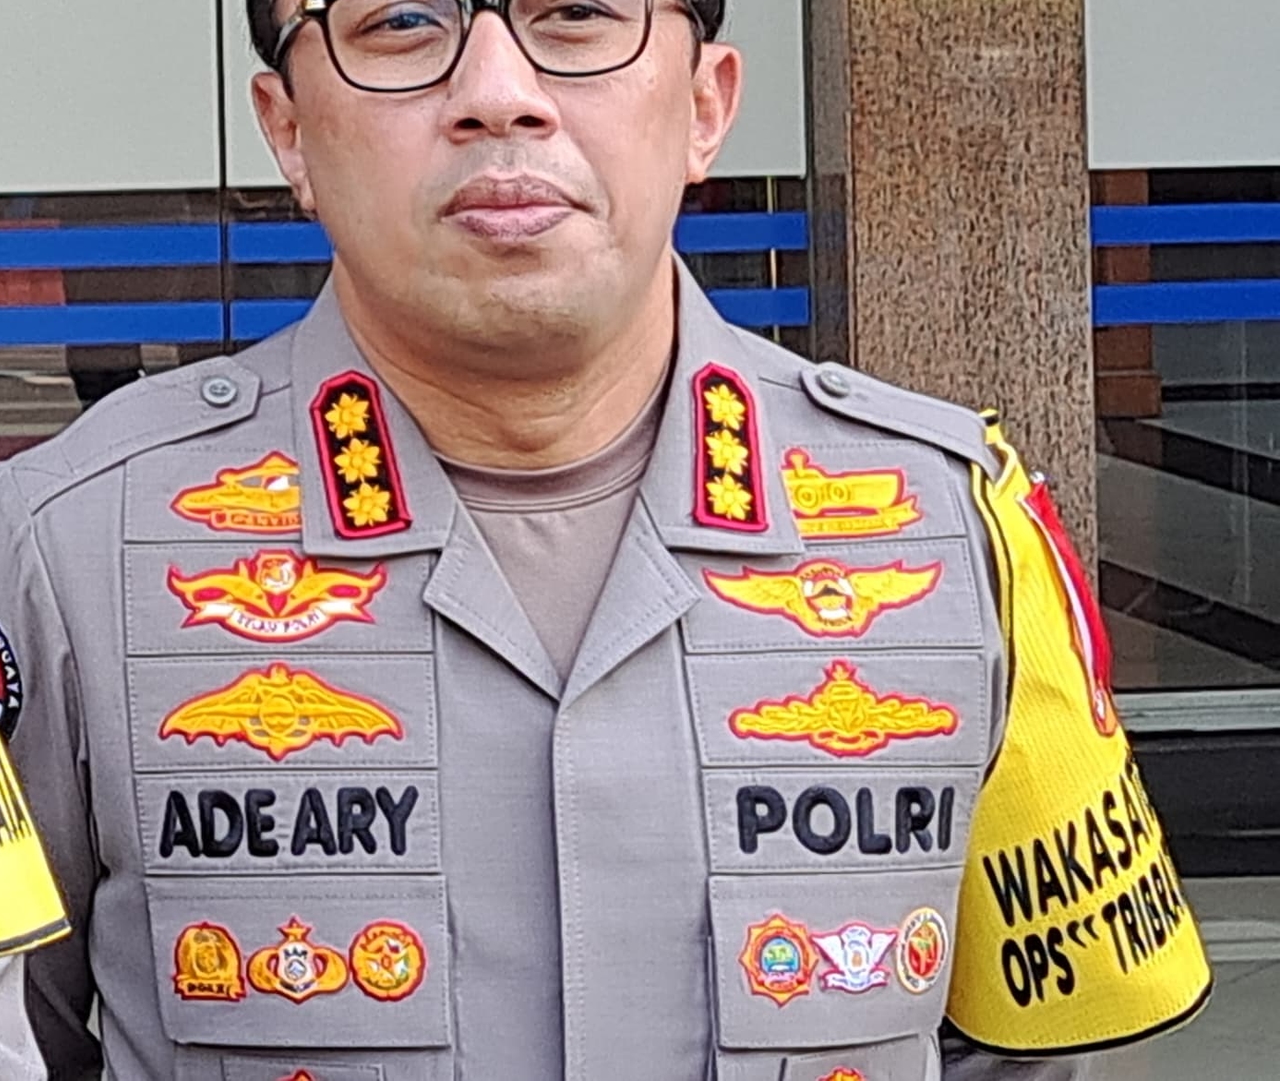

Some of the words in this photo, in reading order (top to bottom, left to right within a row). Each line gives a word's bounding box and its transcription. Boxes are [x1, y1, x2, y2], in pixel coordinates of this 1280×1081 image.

[159, 788, 279, 859] ADE
[290, 785, 419, 857] ARY
[736, 785, 955, 856] POLRI
